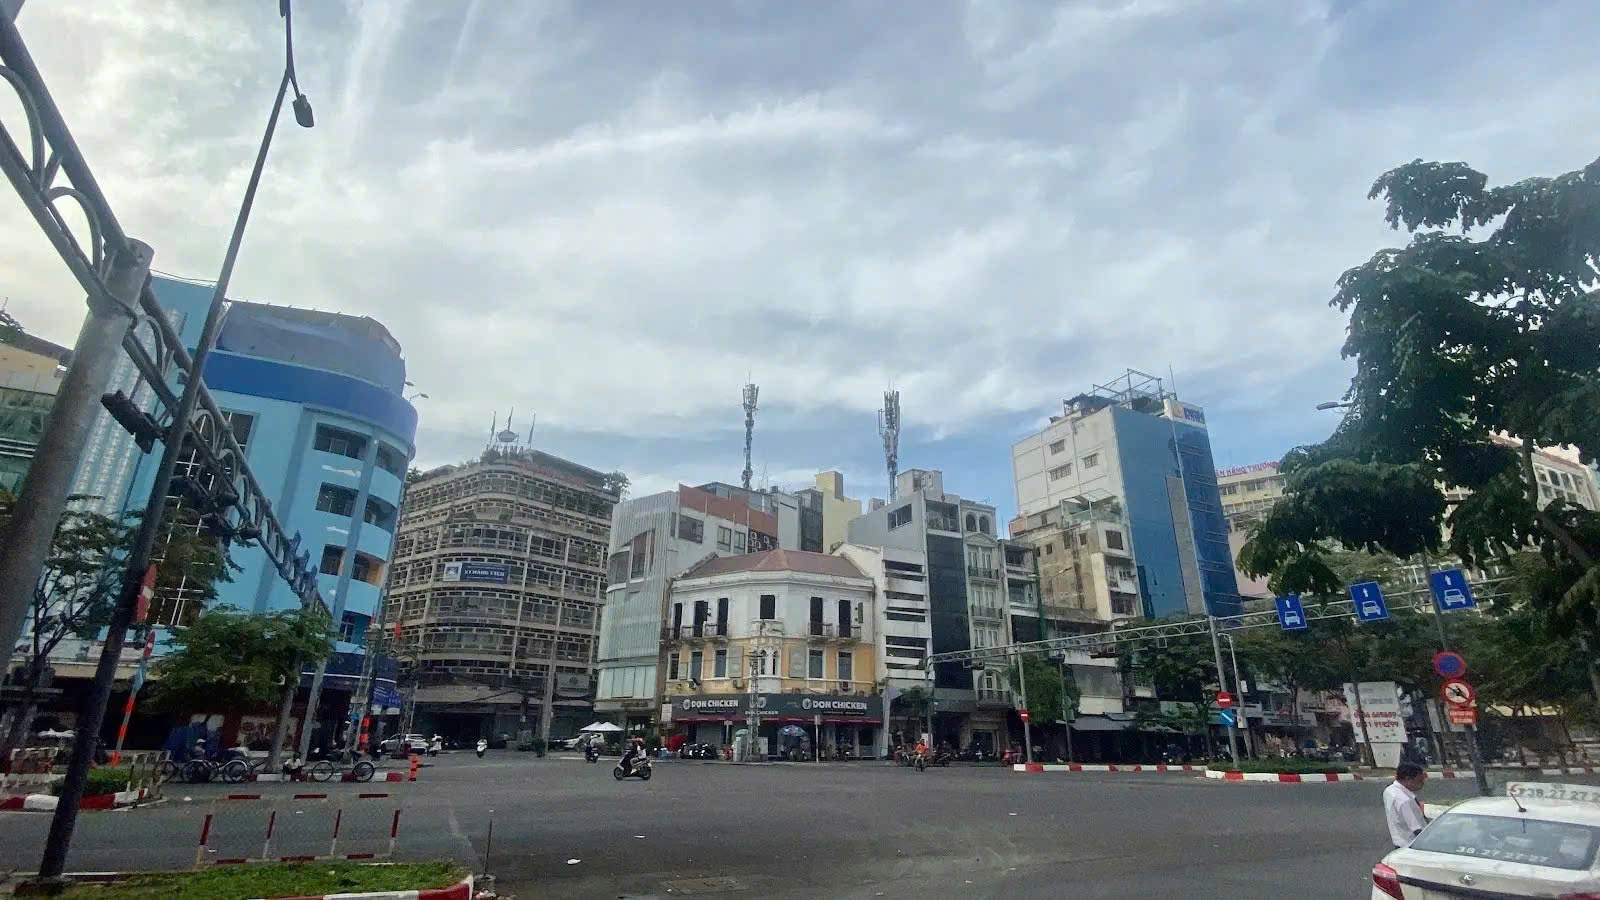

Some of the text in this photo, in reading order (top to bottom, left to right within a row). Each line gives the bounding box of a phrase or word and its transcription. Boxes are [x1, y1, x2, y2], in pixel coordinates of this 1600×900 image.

[691, 699, 739, 708] DON CHICKEN
[812, 700, 868, 710] DON CHICKEN
